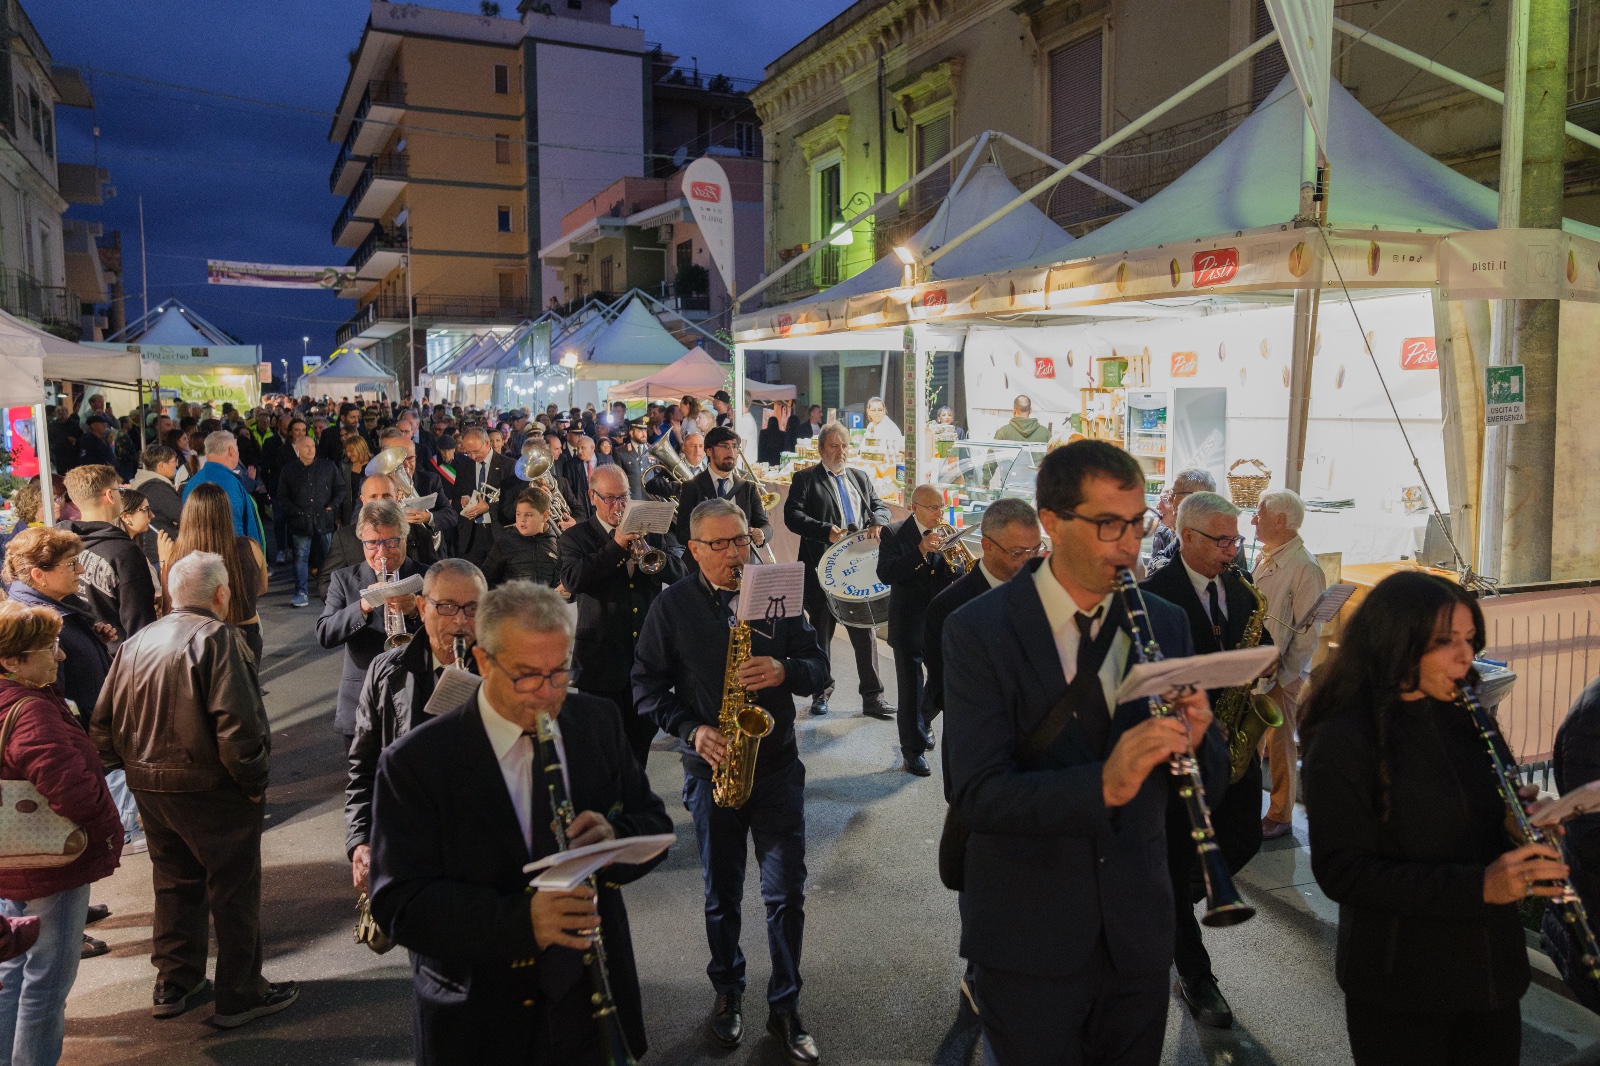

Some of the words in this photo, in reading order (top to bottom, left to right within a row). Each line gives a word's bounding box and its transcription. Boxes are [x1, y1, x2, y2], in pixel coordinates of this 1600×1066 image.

[1196, 255, 1236, 283] Pistì
[1472, 260, 1507, 272] pisti.it
[1404, 341, 1438, 366] Pist
[1487, 414, 1524, 423] EMERGENZA
[1490, 406, 1512, 414] USCITA
[825, 541, 854, 586] Complesso
